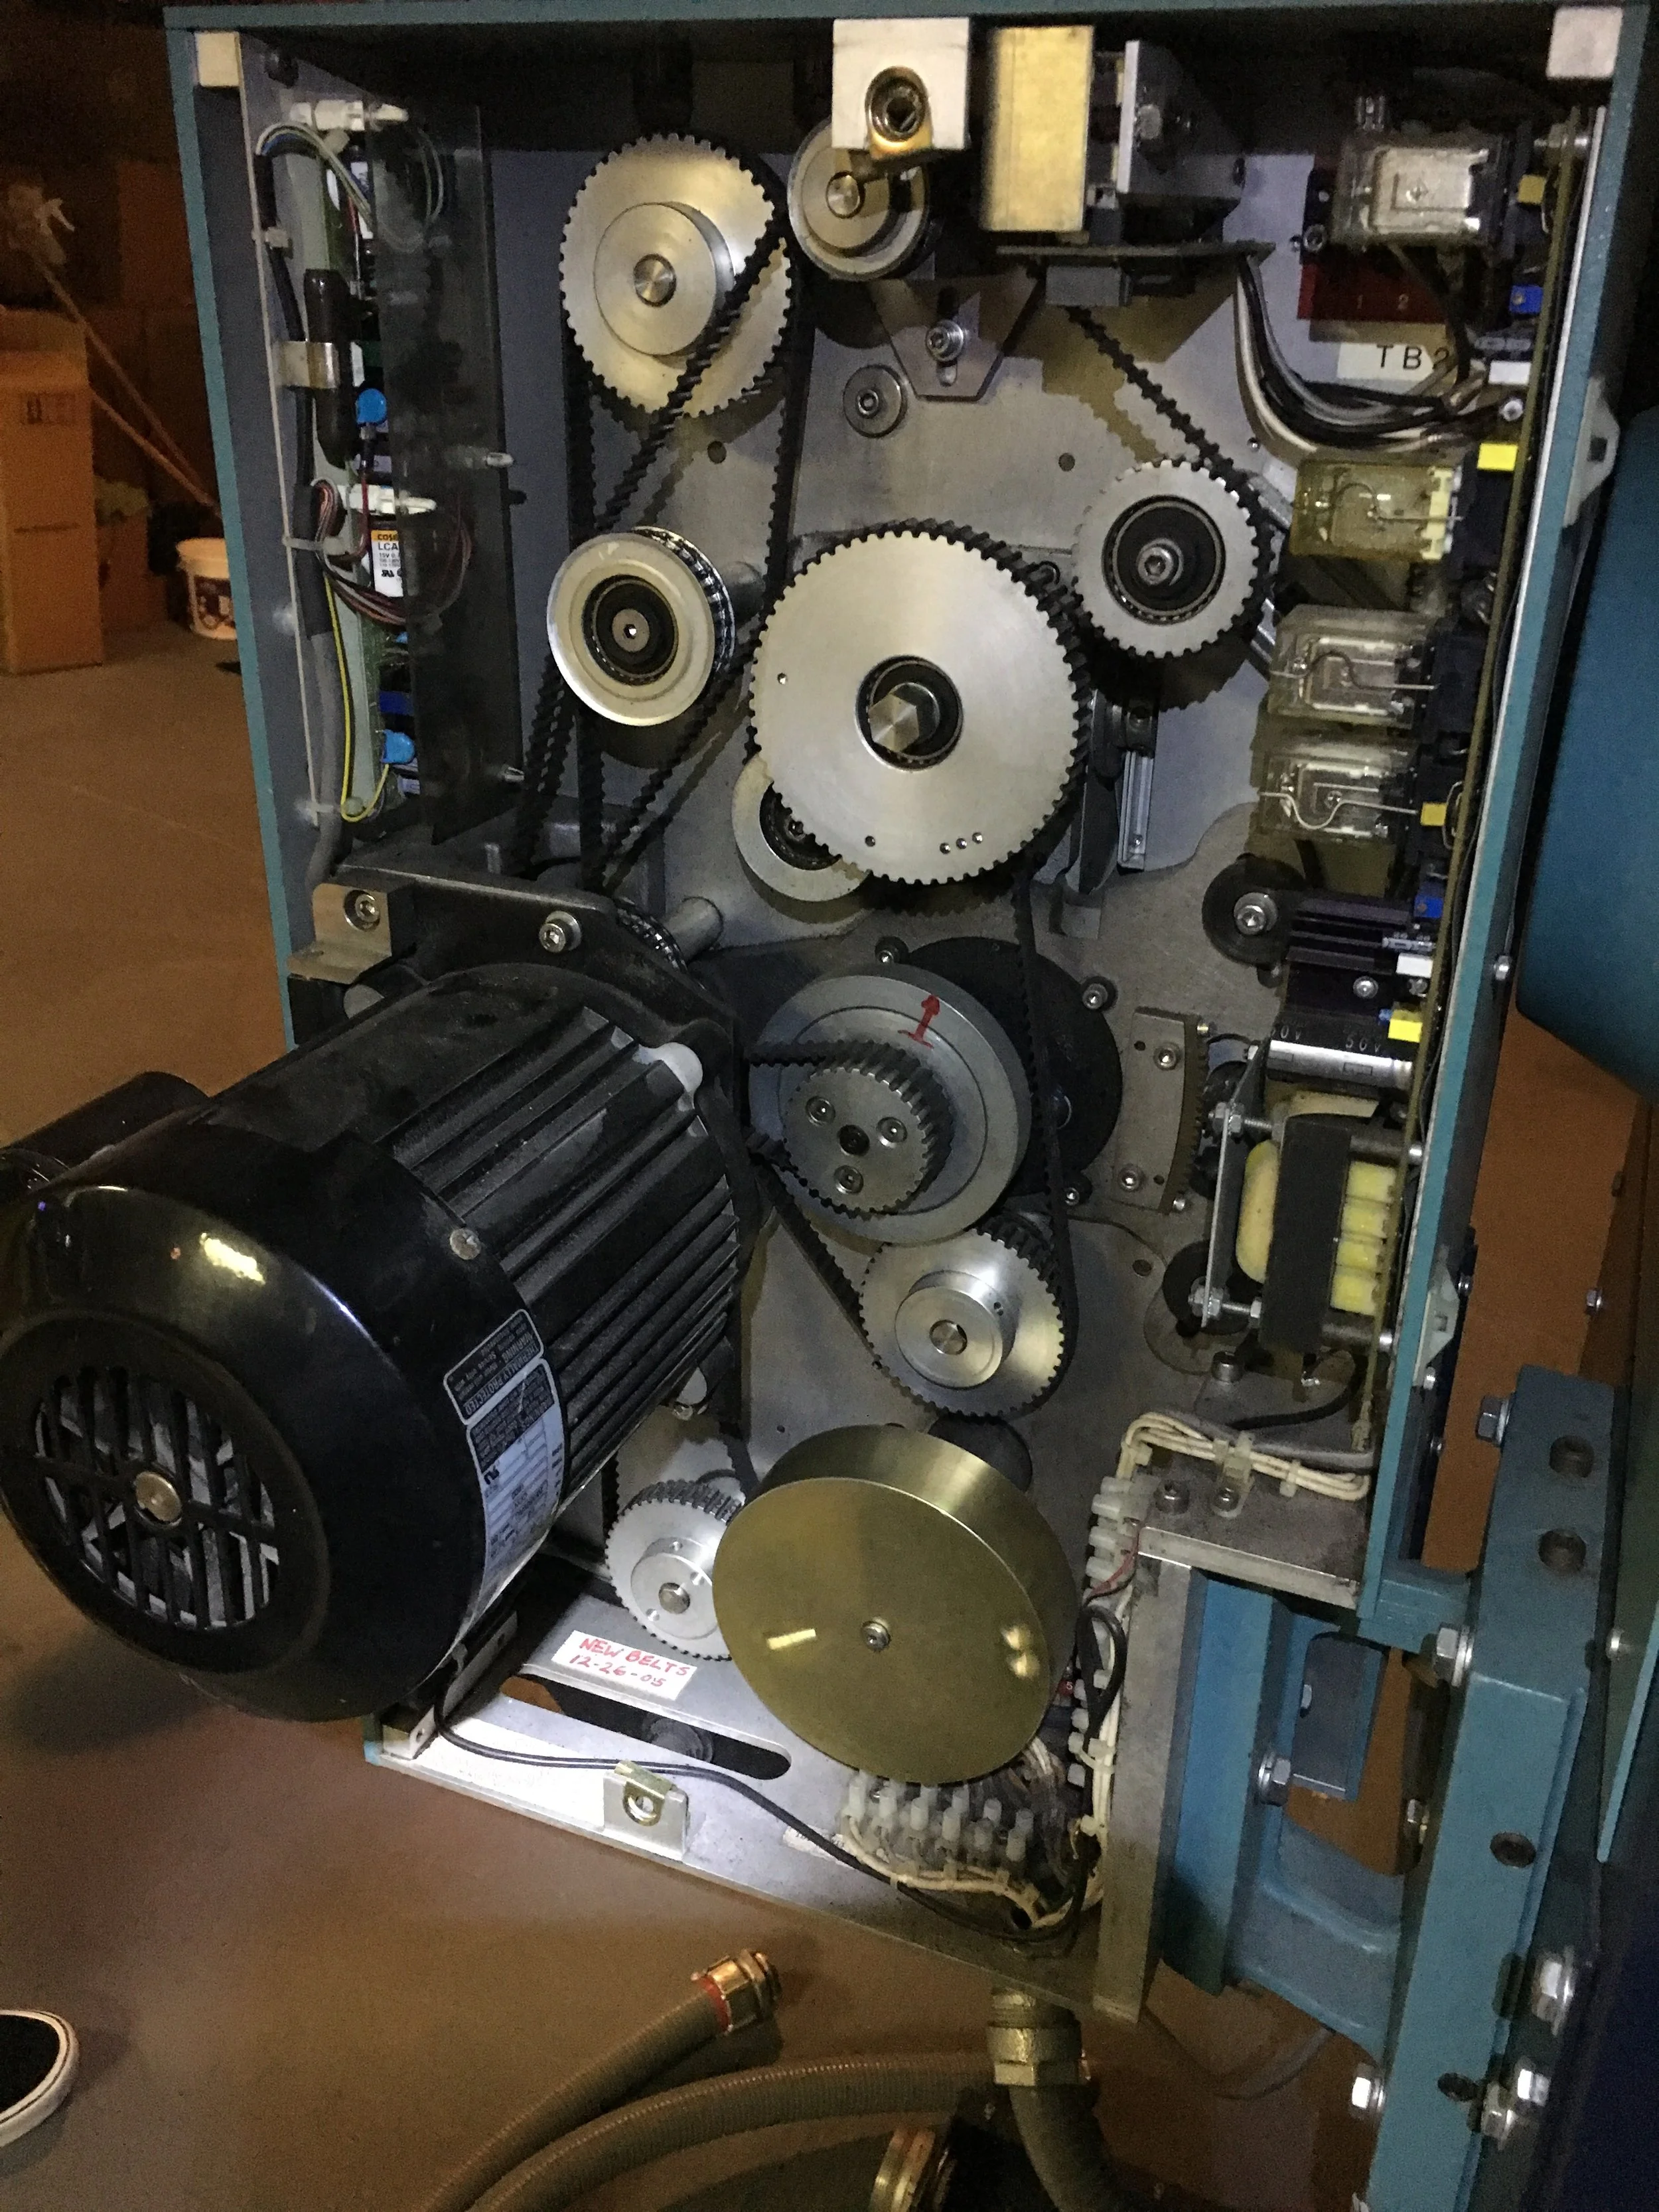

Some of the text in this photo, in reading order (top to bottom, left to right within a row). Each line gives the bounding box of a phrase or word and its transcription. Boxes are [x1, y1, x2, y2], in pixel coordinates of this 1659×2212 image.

[500, 1331, 534, 1363] WARNING
[501, 1342, 540, 1381] THERMALLY
[465, 1374, 505, 1416] PROTECTED
[569, 1655, 666, 1687] 12-26-05
[579, 1638, 690, 1676] NEW BELTS
